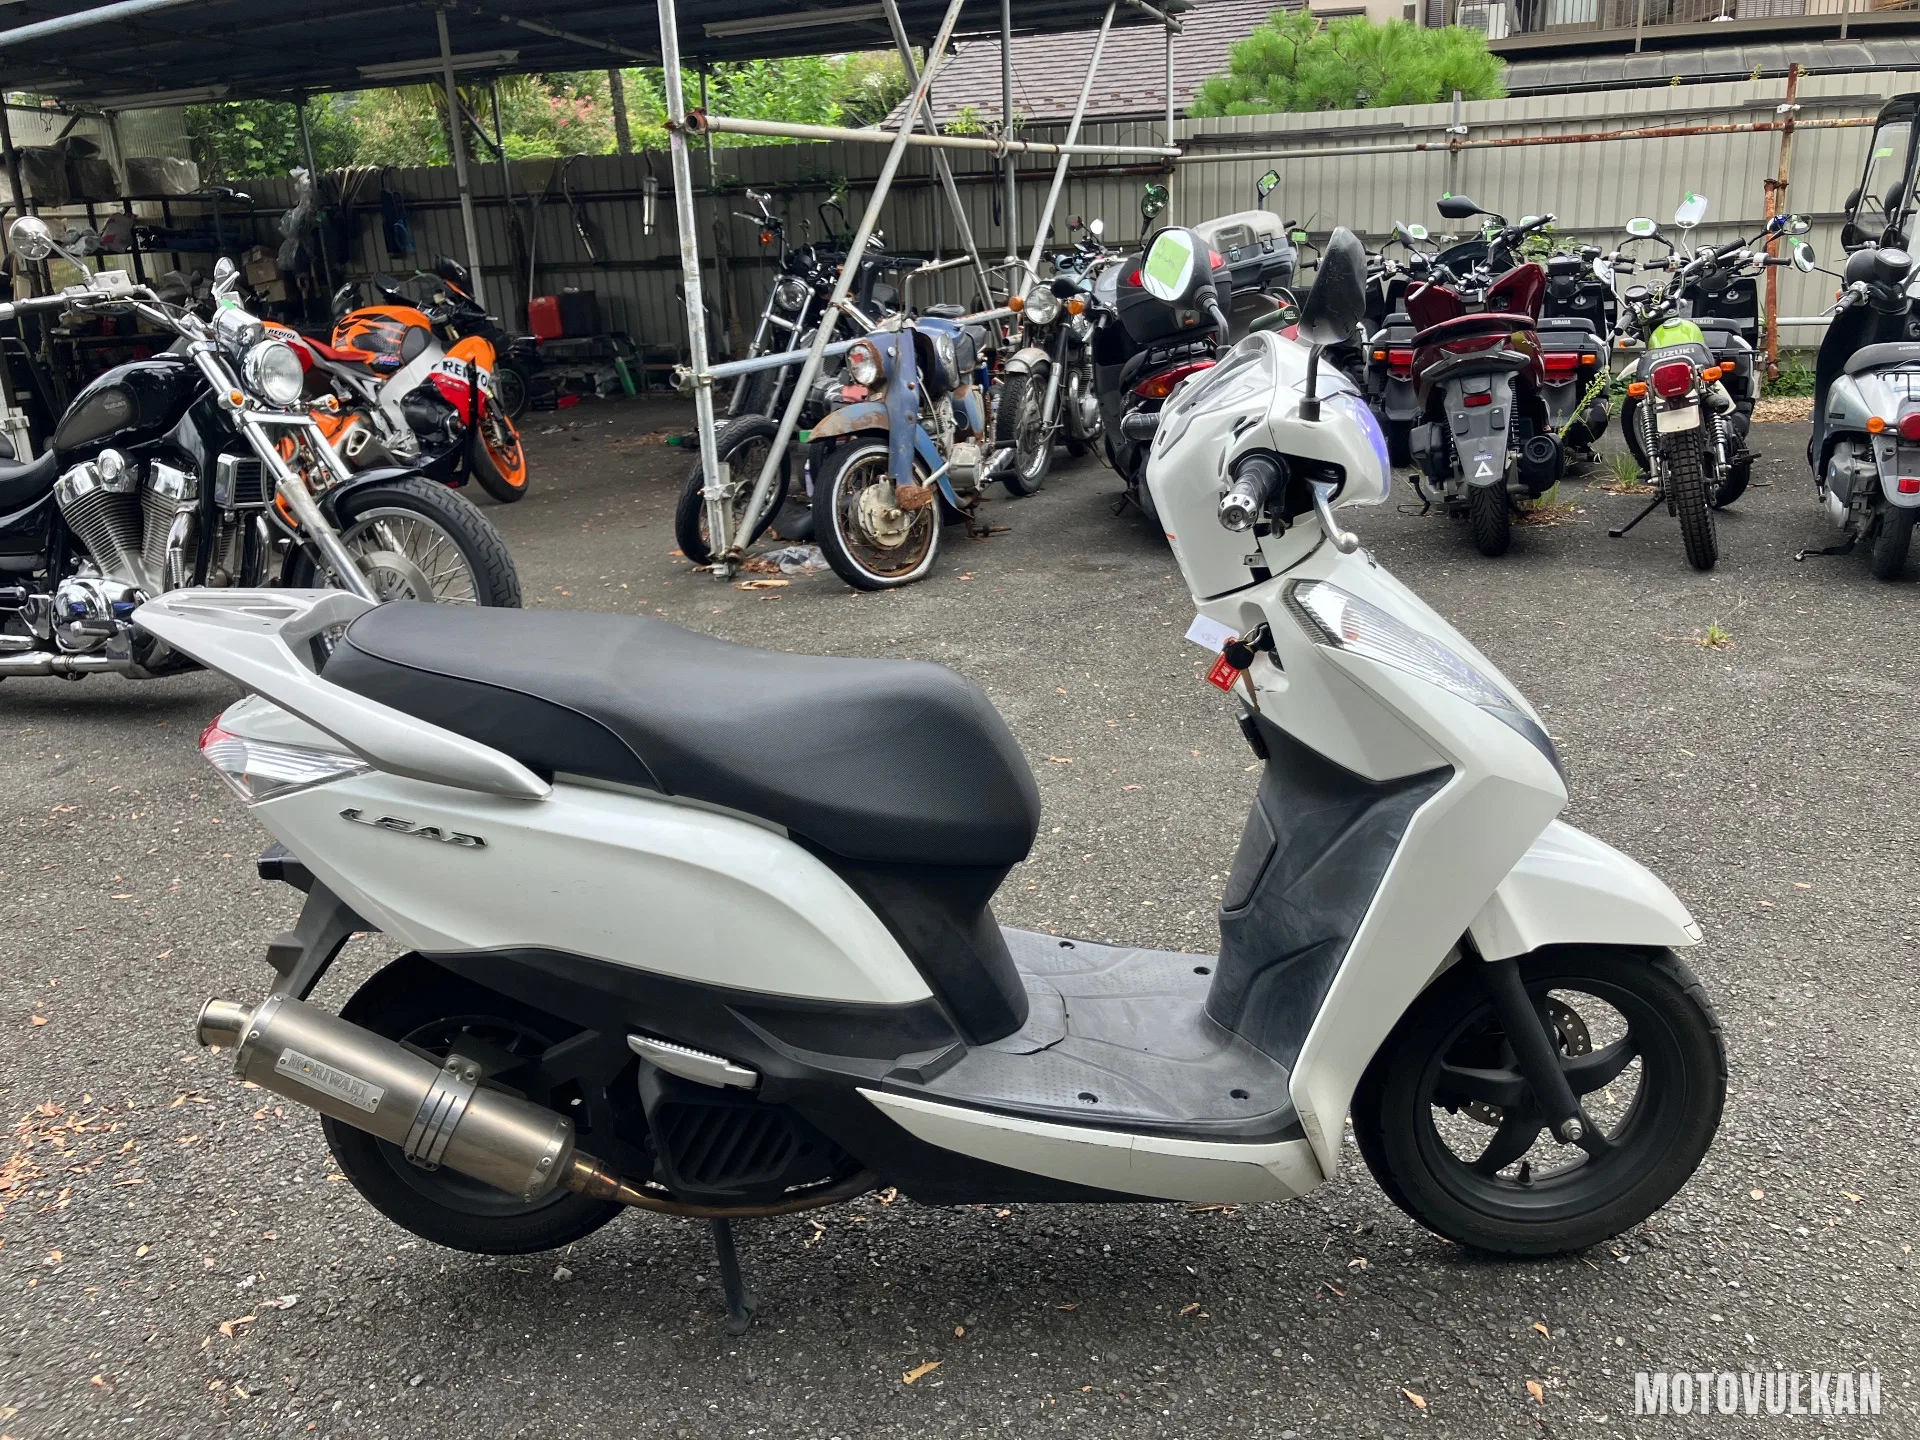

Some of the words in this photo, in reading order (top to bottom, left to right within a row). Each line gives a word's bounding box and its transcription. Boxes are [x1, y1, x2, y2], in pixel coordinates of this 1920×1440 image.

[1651, 347, 1695, 360] SUZUKI
[339, 807, 489, 848] LEAD
[287, 1053, 370, 1099] MORIWAKI
